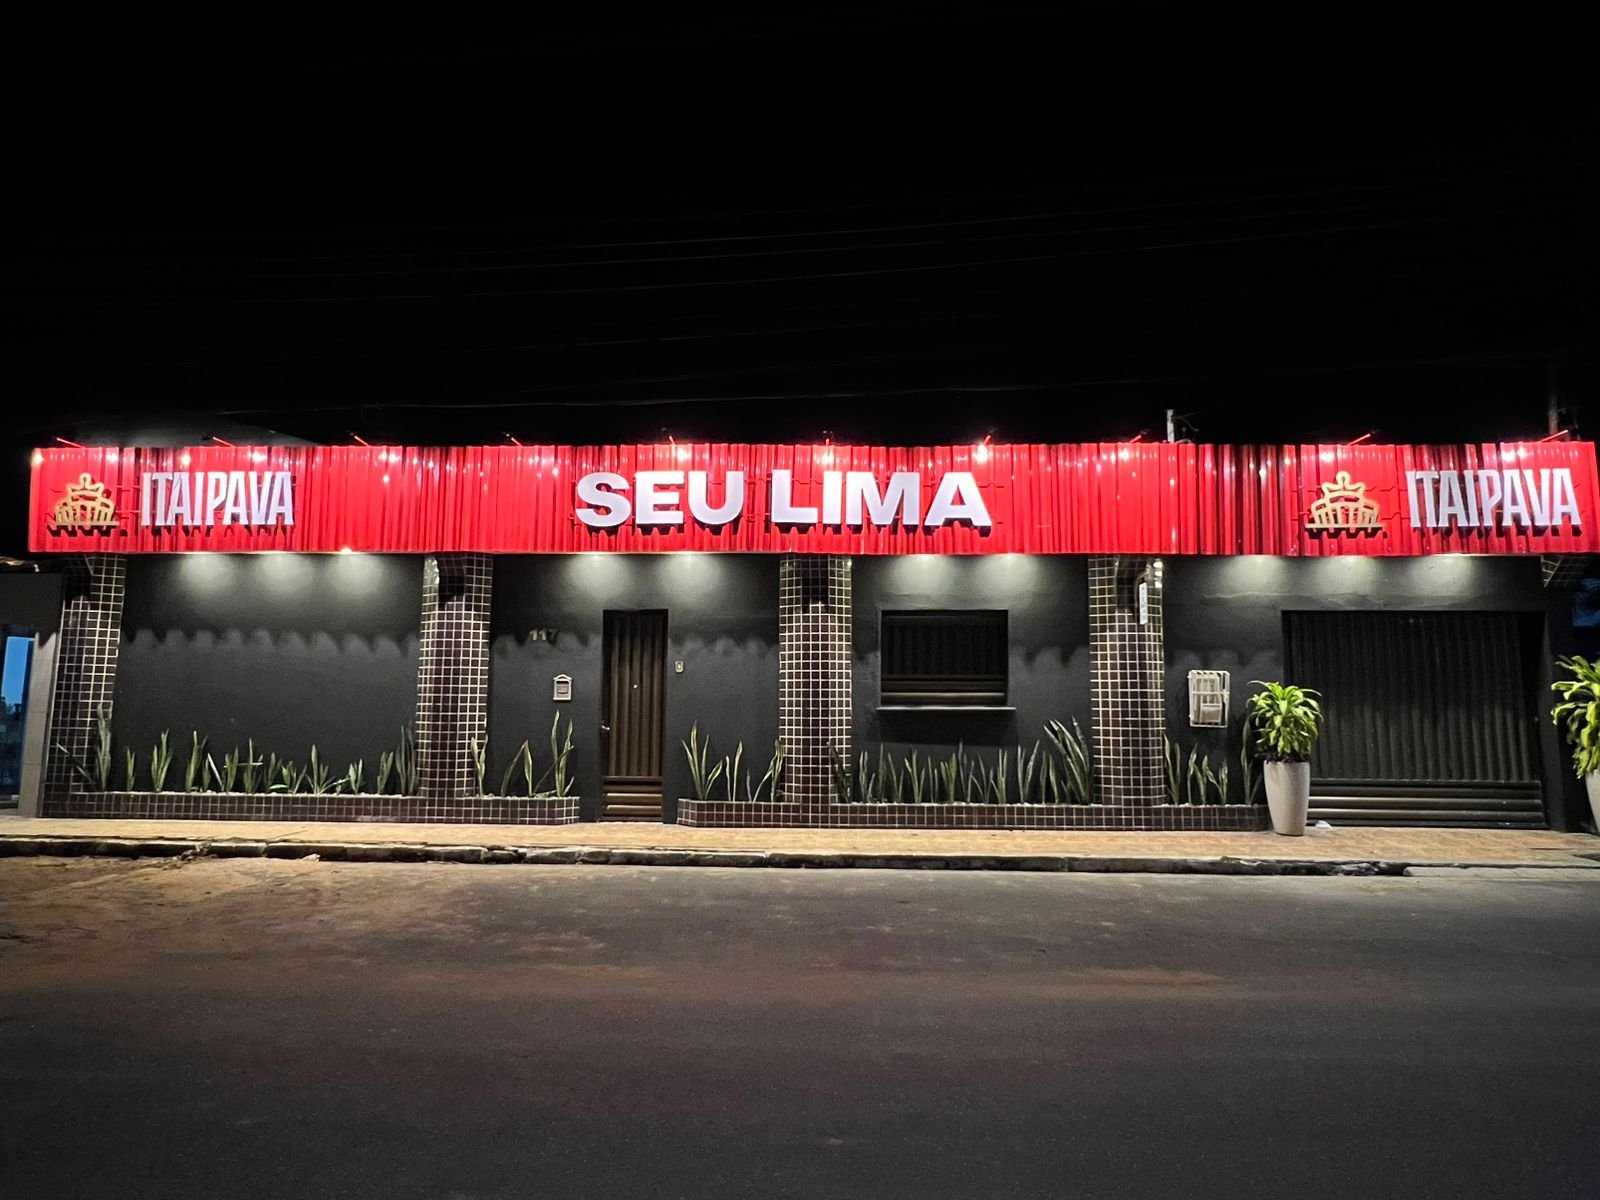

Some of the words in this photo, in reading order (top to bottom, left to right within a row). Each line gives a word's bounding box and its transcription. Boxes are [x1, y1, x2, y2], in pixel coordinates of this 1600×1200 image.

[141, 471, 295, 526] ITAIPAVA
[575, 471, 744, 526] SEU
[771, 469, 992, 527] LIMA
[1406, 468, 1582, 526] ITAIPAVA
[529, 628, 558, 641] 117
